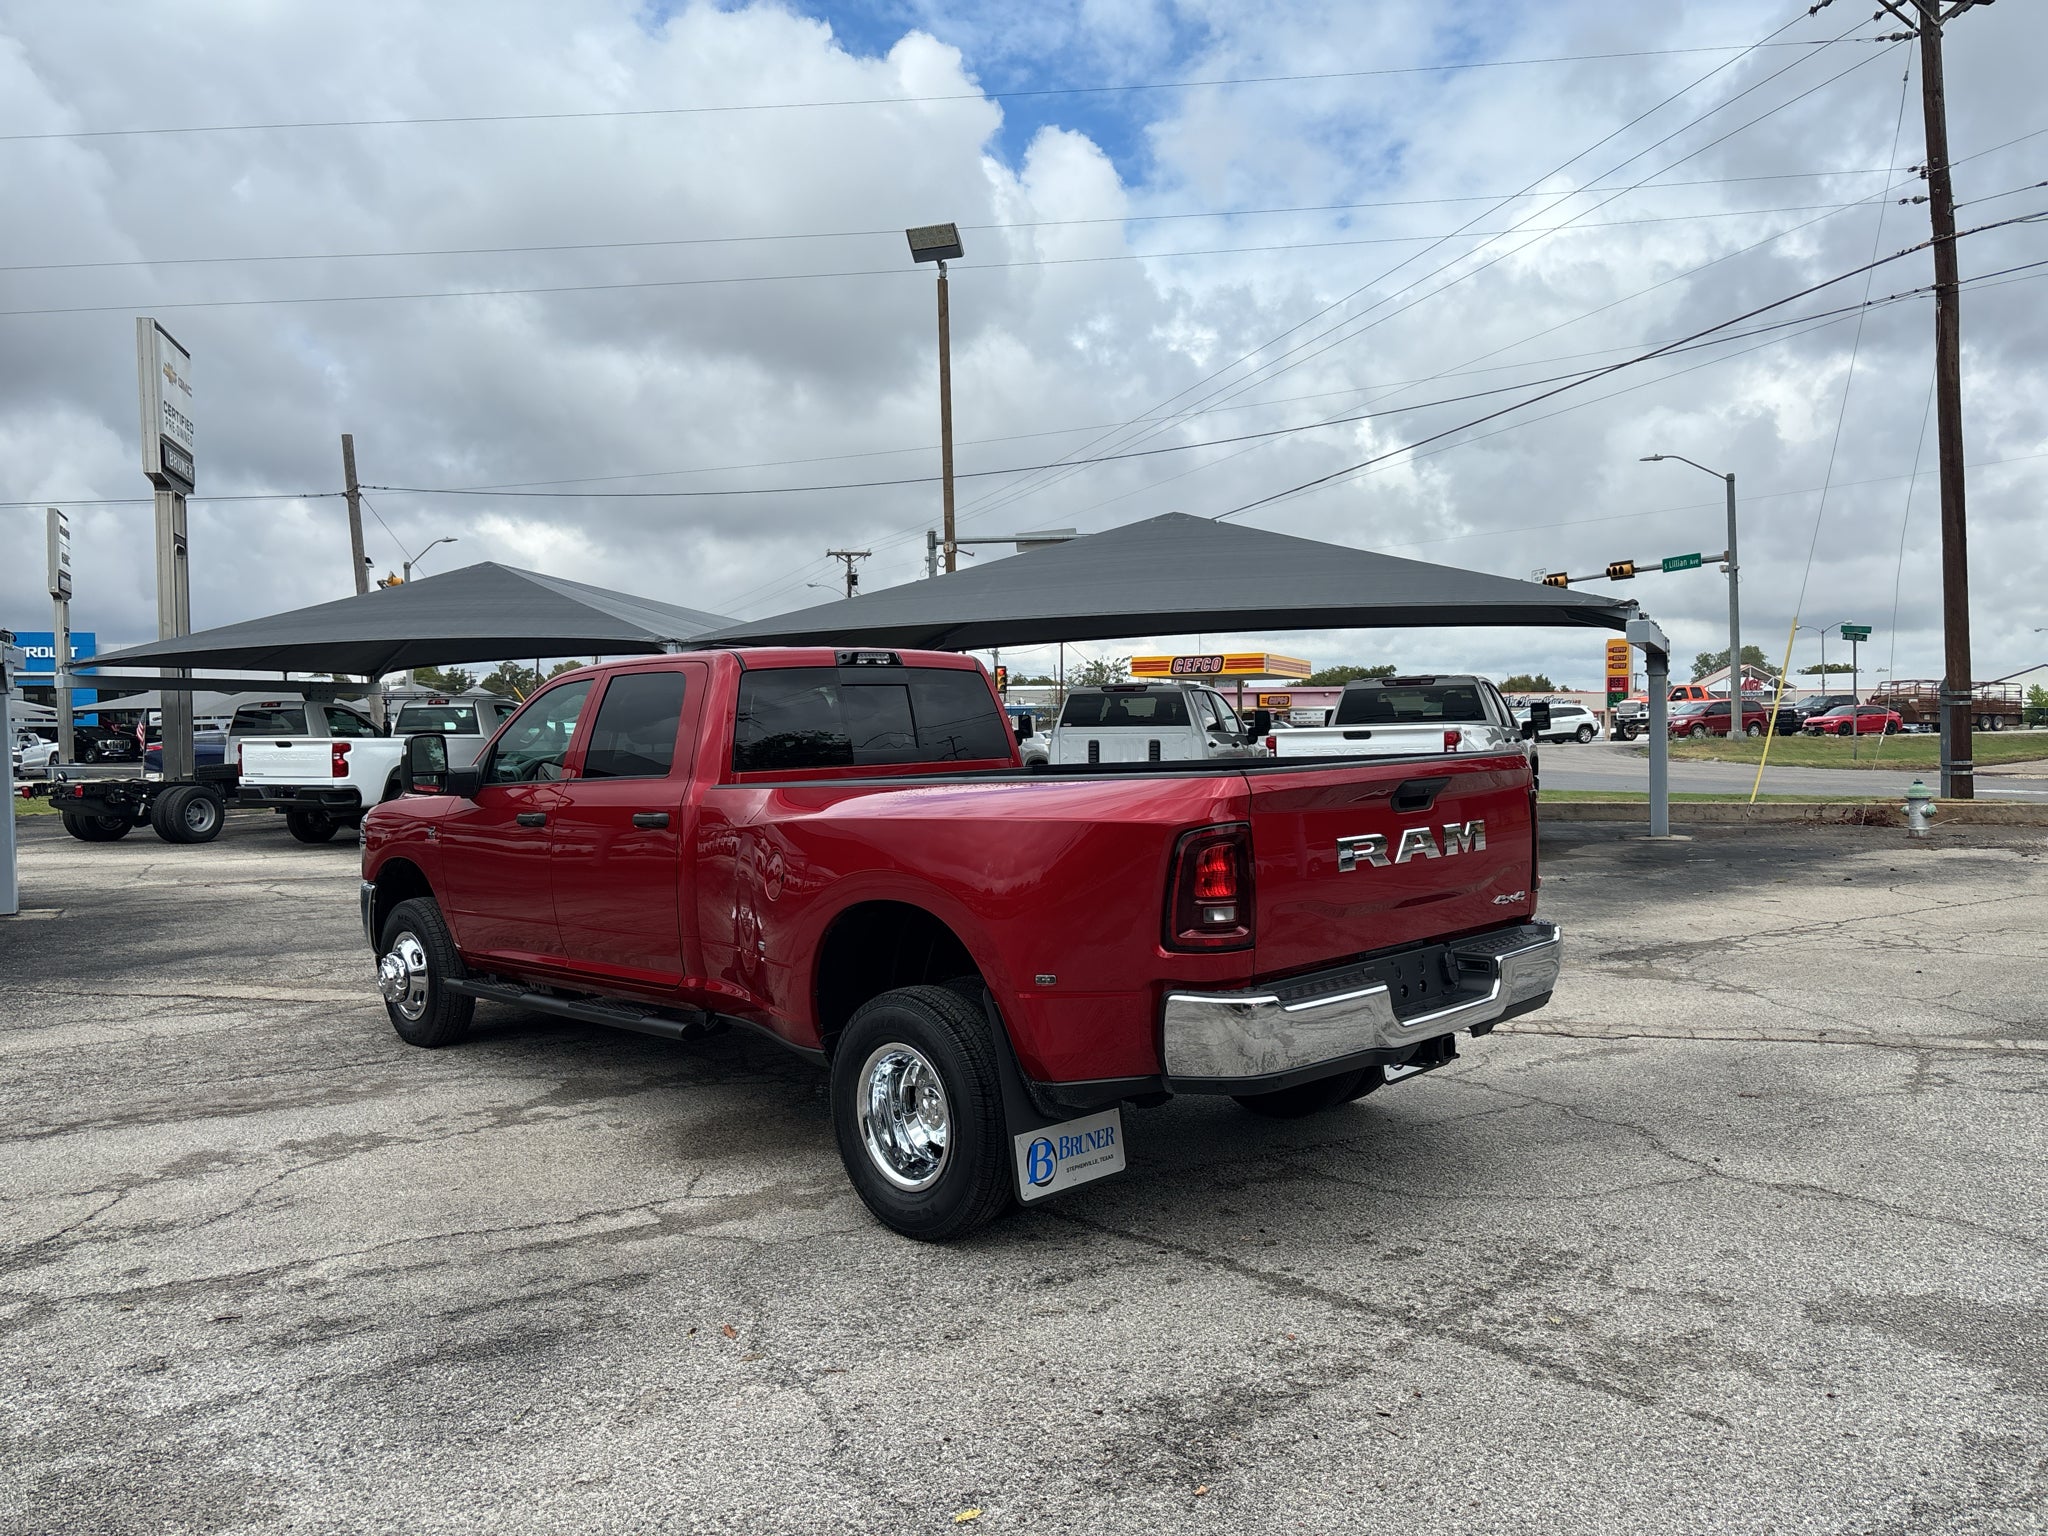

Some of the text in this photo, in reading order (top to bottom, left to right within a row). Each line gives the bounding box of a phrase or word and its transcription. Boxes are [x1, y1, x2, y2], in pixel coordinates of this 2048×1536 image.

[163, 401, 194, 435] CERTIFIED
[165, 417, 193, 447] PRE-OWNED
[169, 451, 193, 480] BRUNER
[1669, 559, 1688, 569] Lillian
[1173, 656, 1222, 673] CEFCO
[1336, 819, 1487, 873] RAM
[1058, 1126, 1115, 1161] BRUNER
[1099, 1153, 1114, 1164] TEXAS
